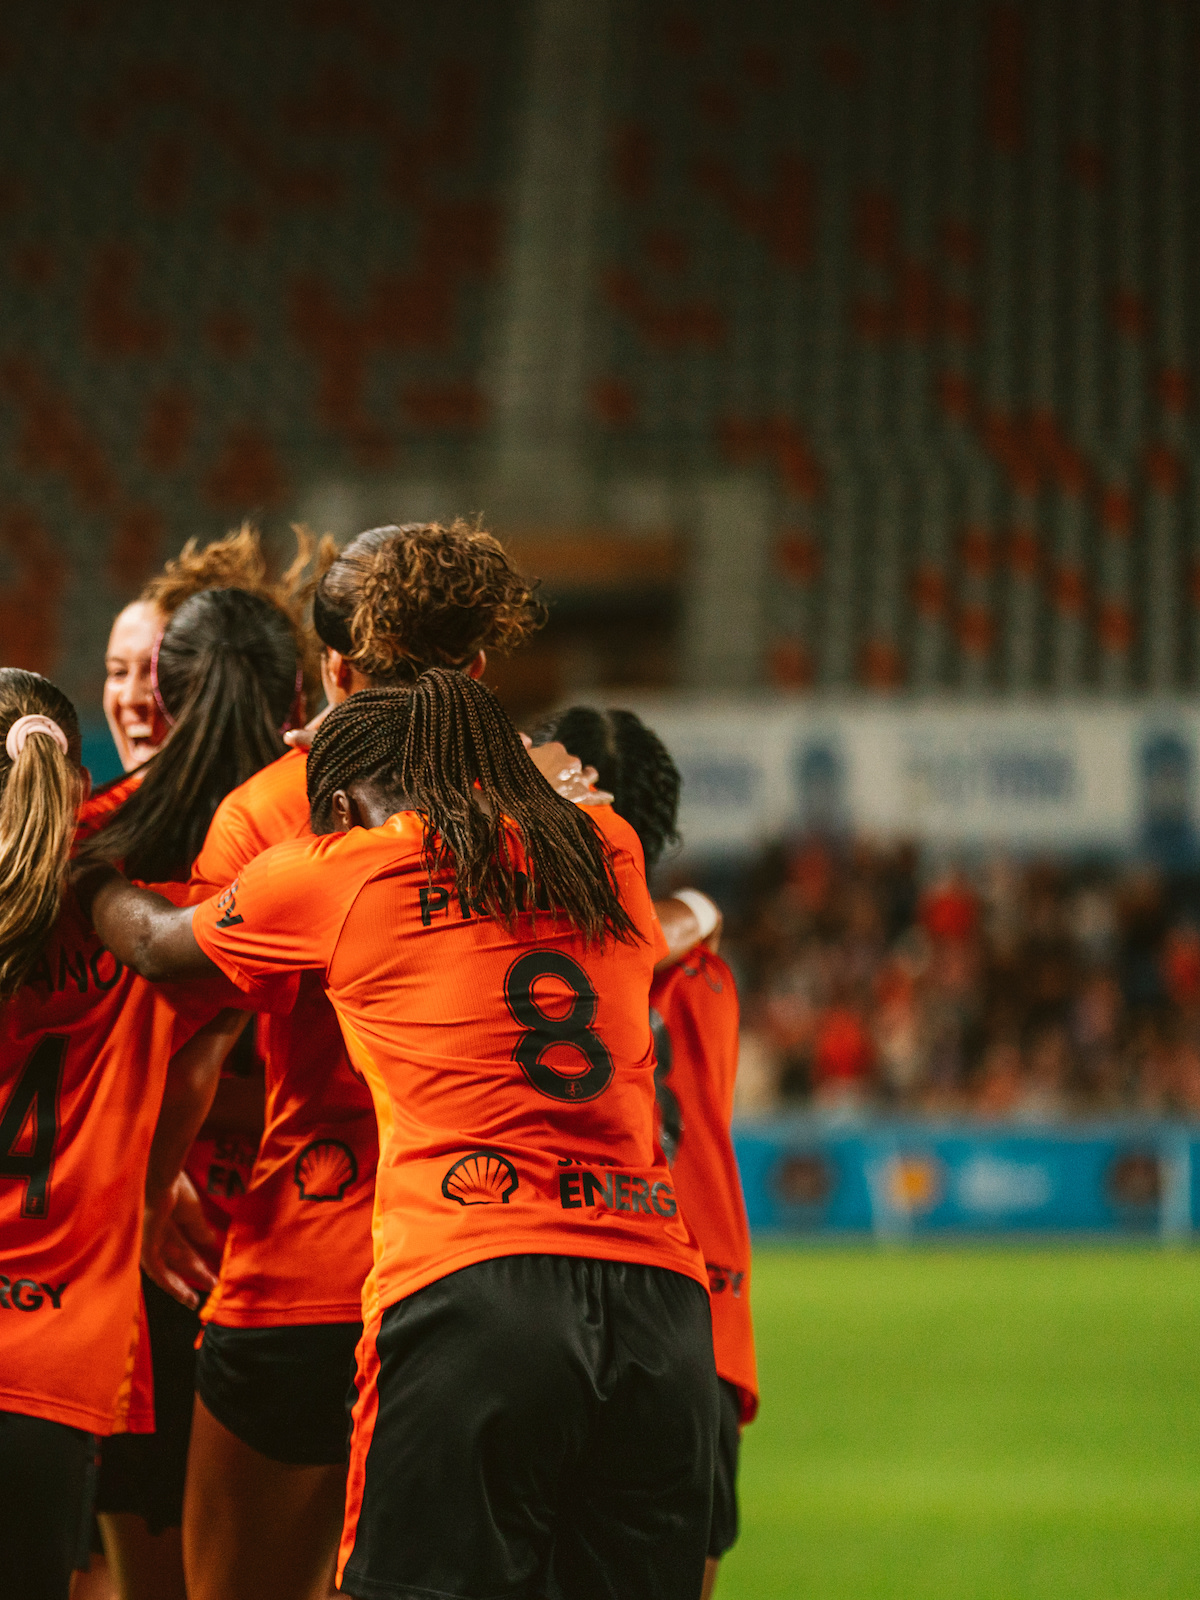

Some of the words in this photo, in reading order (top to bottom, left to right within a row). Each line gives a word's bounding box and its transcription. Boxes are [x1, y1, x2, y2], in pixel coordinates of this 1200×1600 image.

[25, 944, 124, 993] ANO
[504, 948, 615, 1104] 8
[559, 1171, 677, 1218] ENERG
